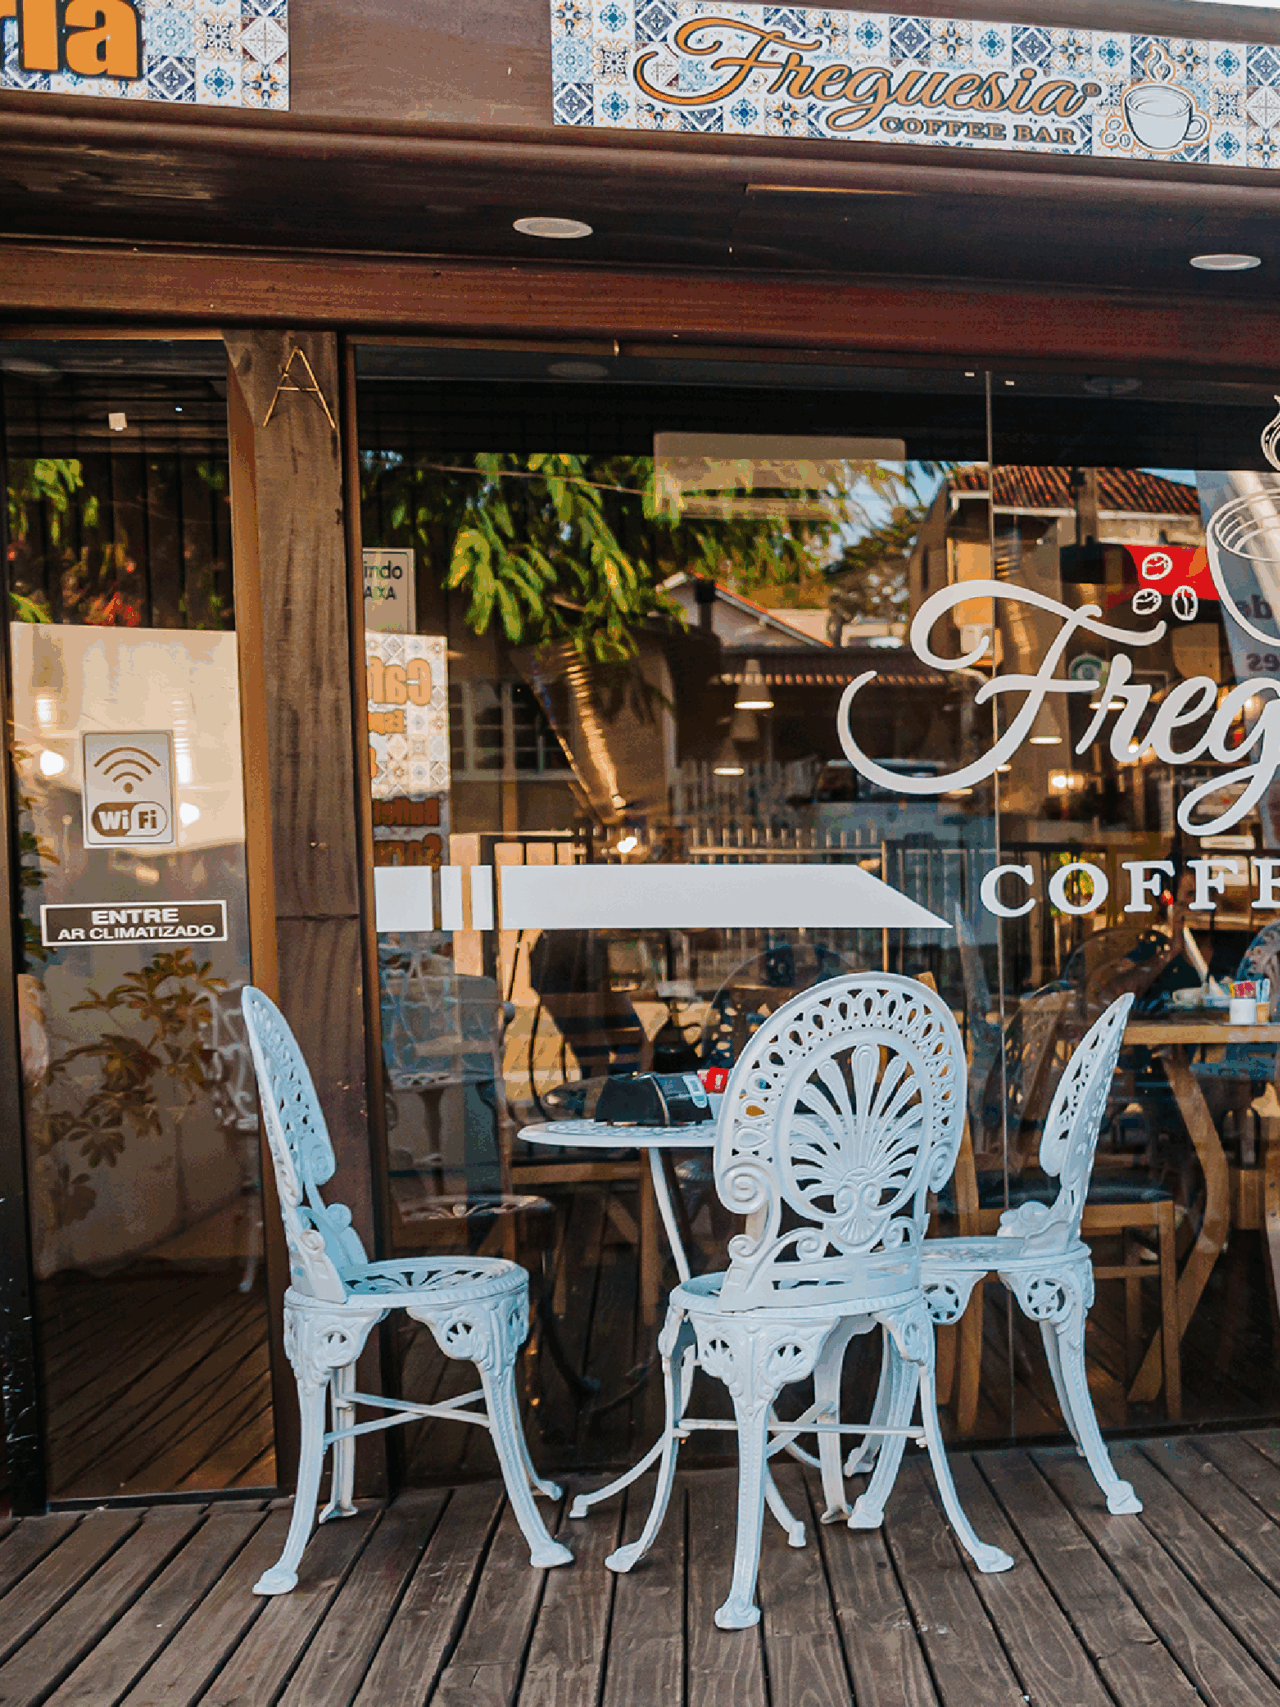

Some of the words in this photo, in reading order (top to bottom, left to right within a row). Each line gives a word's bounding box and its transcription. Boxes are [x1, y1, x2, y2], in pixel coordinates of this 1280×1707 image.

[0, 0, 144, 81] ia
[879, 116, 1007, 142] COFFEE
[1014, 125, 1078, 146] BAR
[91, 907, 180, 926] ENTRE
[57, 927, 86, 941] AR
[89, 924, 216, 940] CLIMATIZADO
